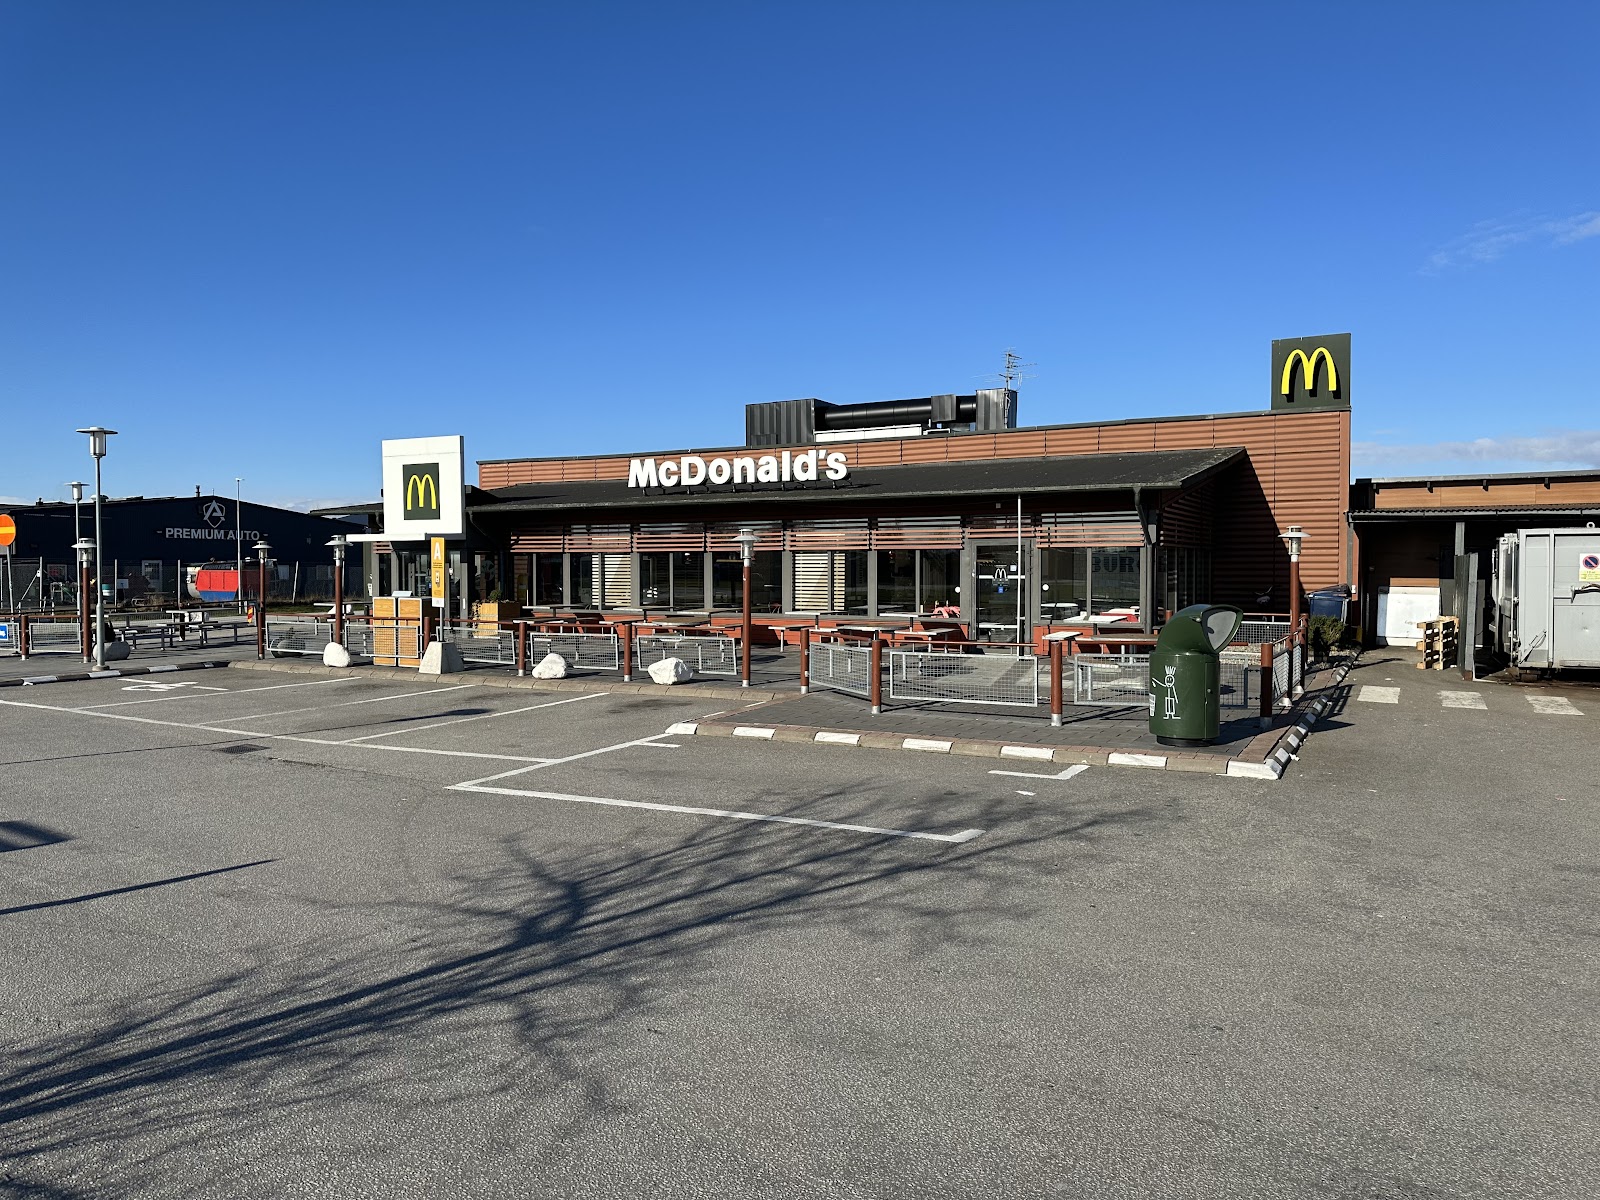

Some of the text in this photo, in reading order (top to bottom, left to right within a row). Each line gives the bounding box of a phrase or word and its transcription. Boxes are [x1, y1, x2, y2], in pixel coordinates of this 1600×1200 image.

[627, 450, 848, 488] McDonald's
[165, 527, 260, 541] PREMIUM AUTO
